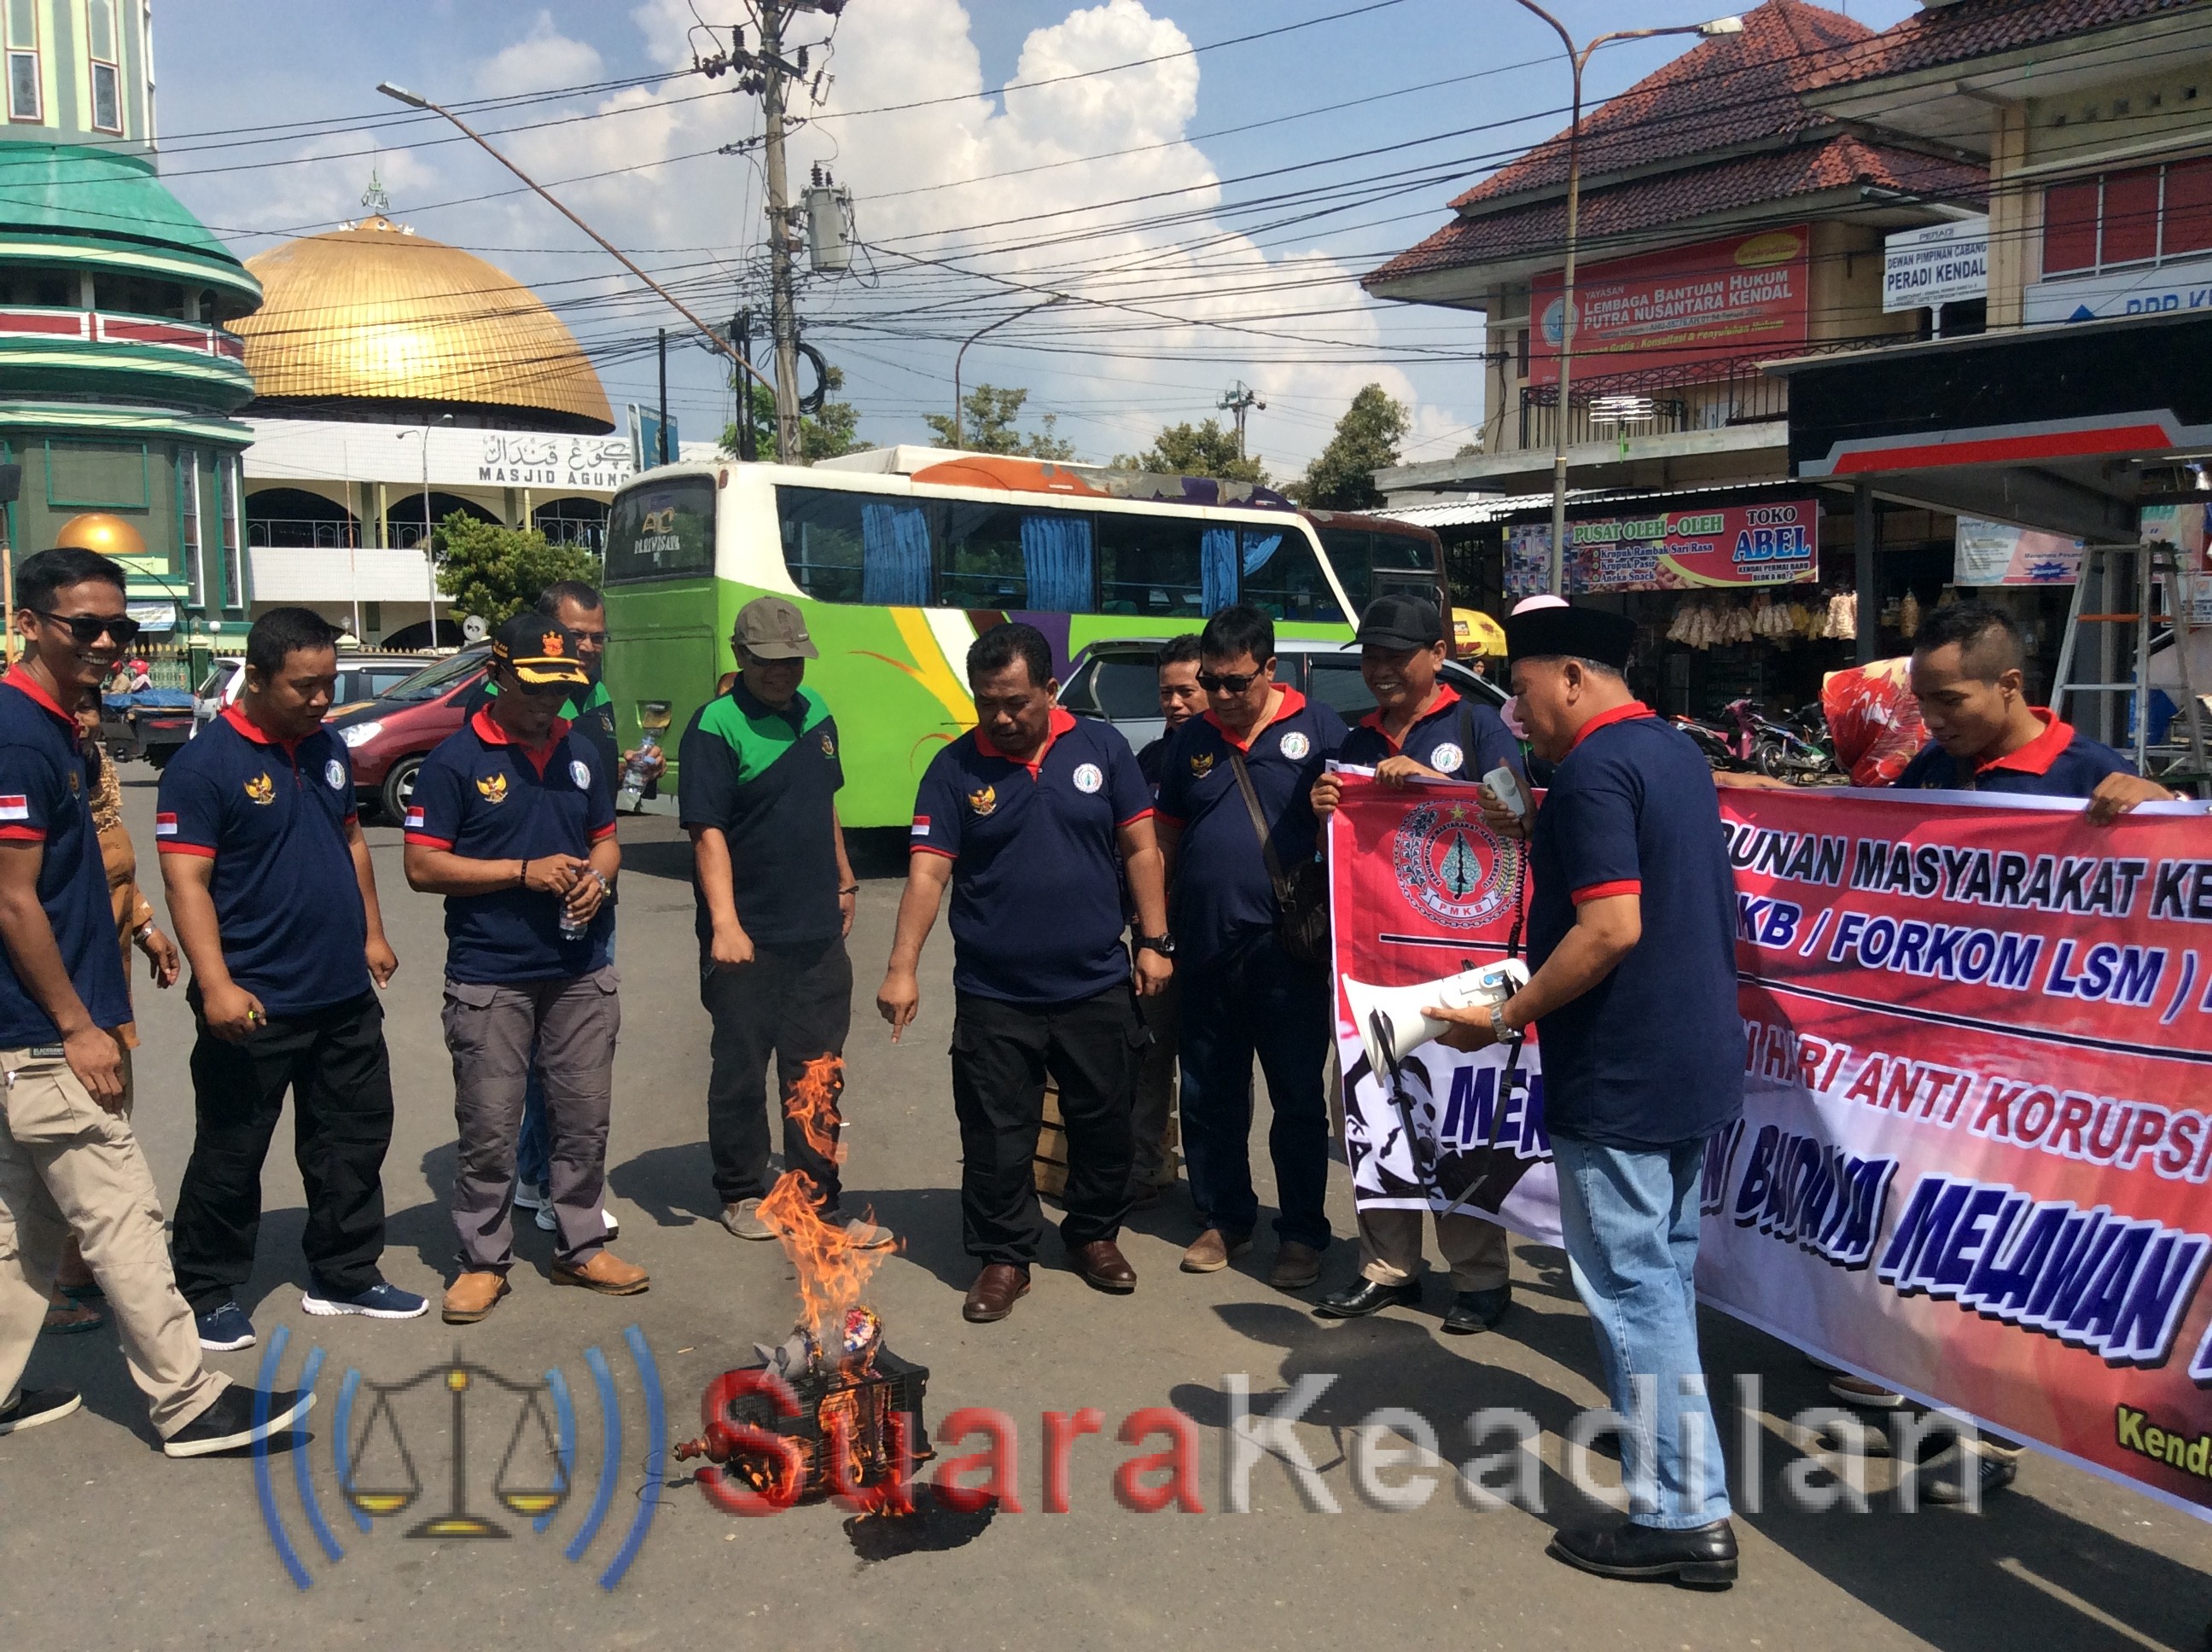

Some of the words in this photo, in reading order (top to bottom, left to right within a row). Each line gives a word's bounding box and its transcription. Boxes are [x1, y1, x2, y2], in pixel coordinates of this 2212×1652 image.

[1888, 255, 1914, 270] DEWAN
[1916, 247, 1953, 265] PIMPINAN
[1954, 241, 1987, 257] CABANG
[1888, 267, 1932, 291] PERADI
[1936, 258, 1987, 283] KENDAL
[1584, 311, 1630, 330] PUTRA
[1634, 294, 1724, 321] NUSANTARA
[1729, 283, 1792, 306] KENDAL
[1585, 294, 1649, 315] LEMBAGA
[1655, 281, 1724, 304] BANTUAN
[1729, 270, 1788, 290] HUKUM
[1586, 286, 1625, 299] YAYASAN
[479, 467, 556, 485] MASJID
[642, 506, 675, 534] AC
[1573, 523, 1621, 544] PUSAT
[1623, 519, 1668, 540] OLEH
[1678, 514, 1724, 536] OLEH
[1746, 505, 1797, 526] TOKO
[1601, 548, 1633, 560] Krupuk
[1634, 546, 1668, 557] Rambak
[1672, 544, 1689, 554] Sari
[1691, 542, 1713, 553] Rasa
[1732, 525, 1811, 562] ABEL
[1600, 573, 1627, 583] Aneka
[1628, 571, 1655, 581] Snack
[1601, 560, 1633, 571] Krupuk
[1634, 559, 1656, 570] Pasir
[1738, 565, 1762, 573] KENDAL
[1763, 563, 1789, 573] PERMAI
[1790, 561, 1809, 571] BARU
[1435, 822, 1479, 835] MASYARAKAT
[1849, 837, 2149, 917] MASYARAKAT
[1827, 910, 2048, 993] FORKOM
[2043, 939, 2169, 1009] LSM
[1843, 1052, 1976, 1127] ANTI
[1734, 1124, 1900, 1271] BUDAYA
[1877, 1172, 2210, 1370] MELAWAN
